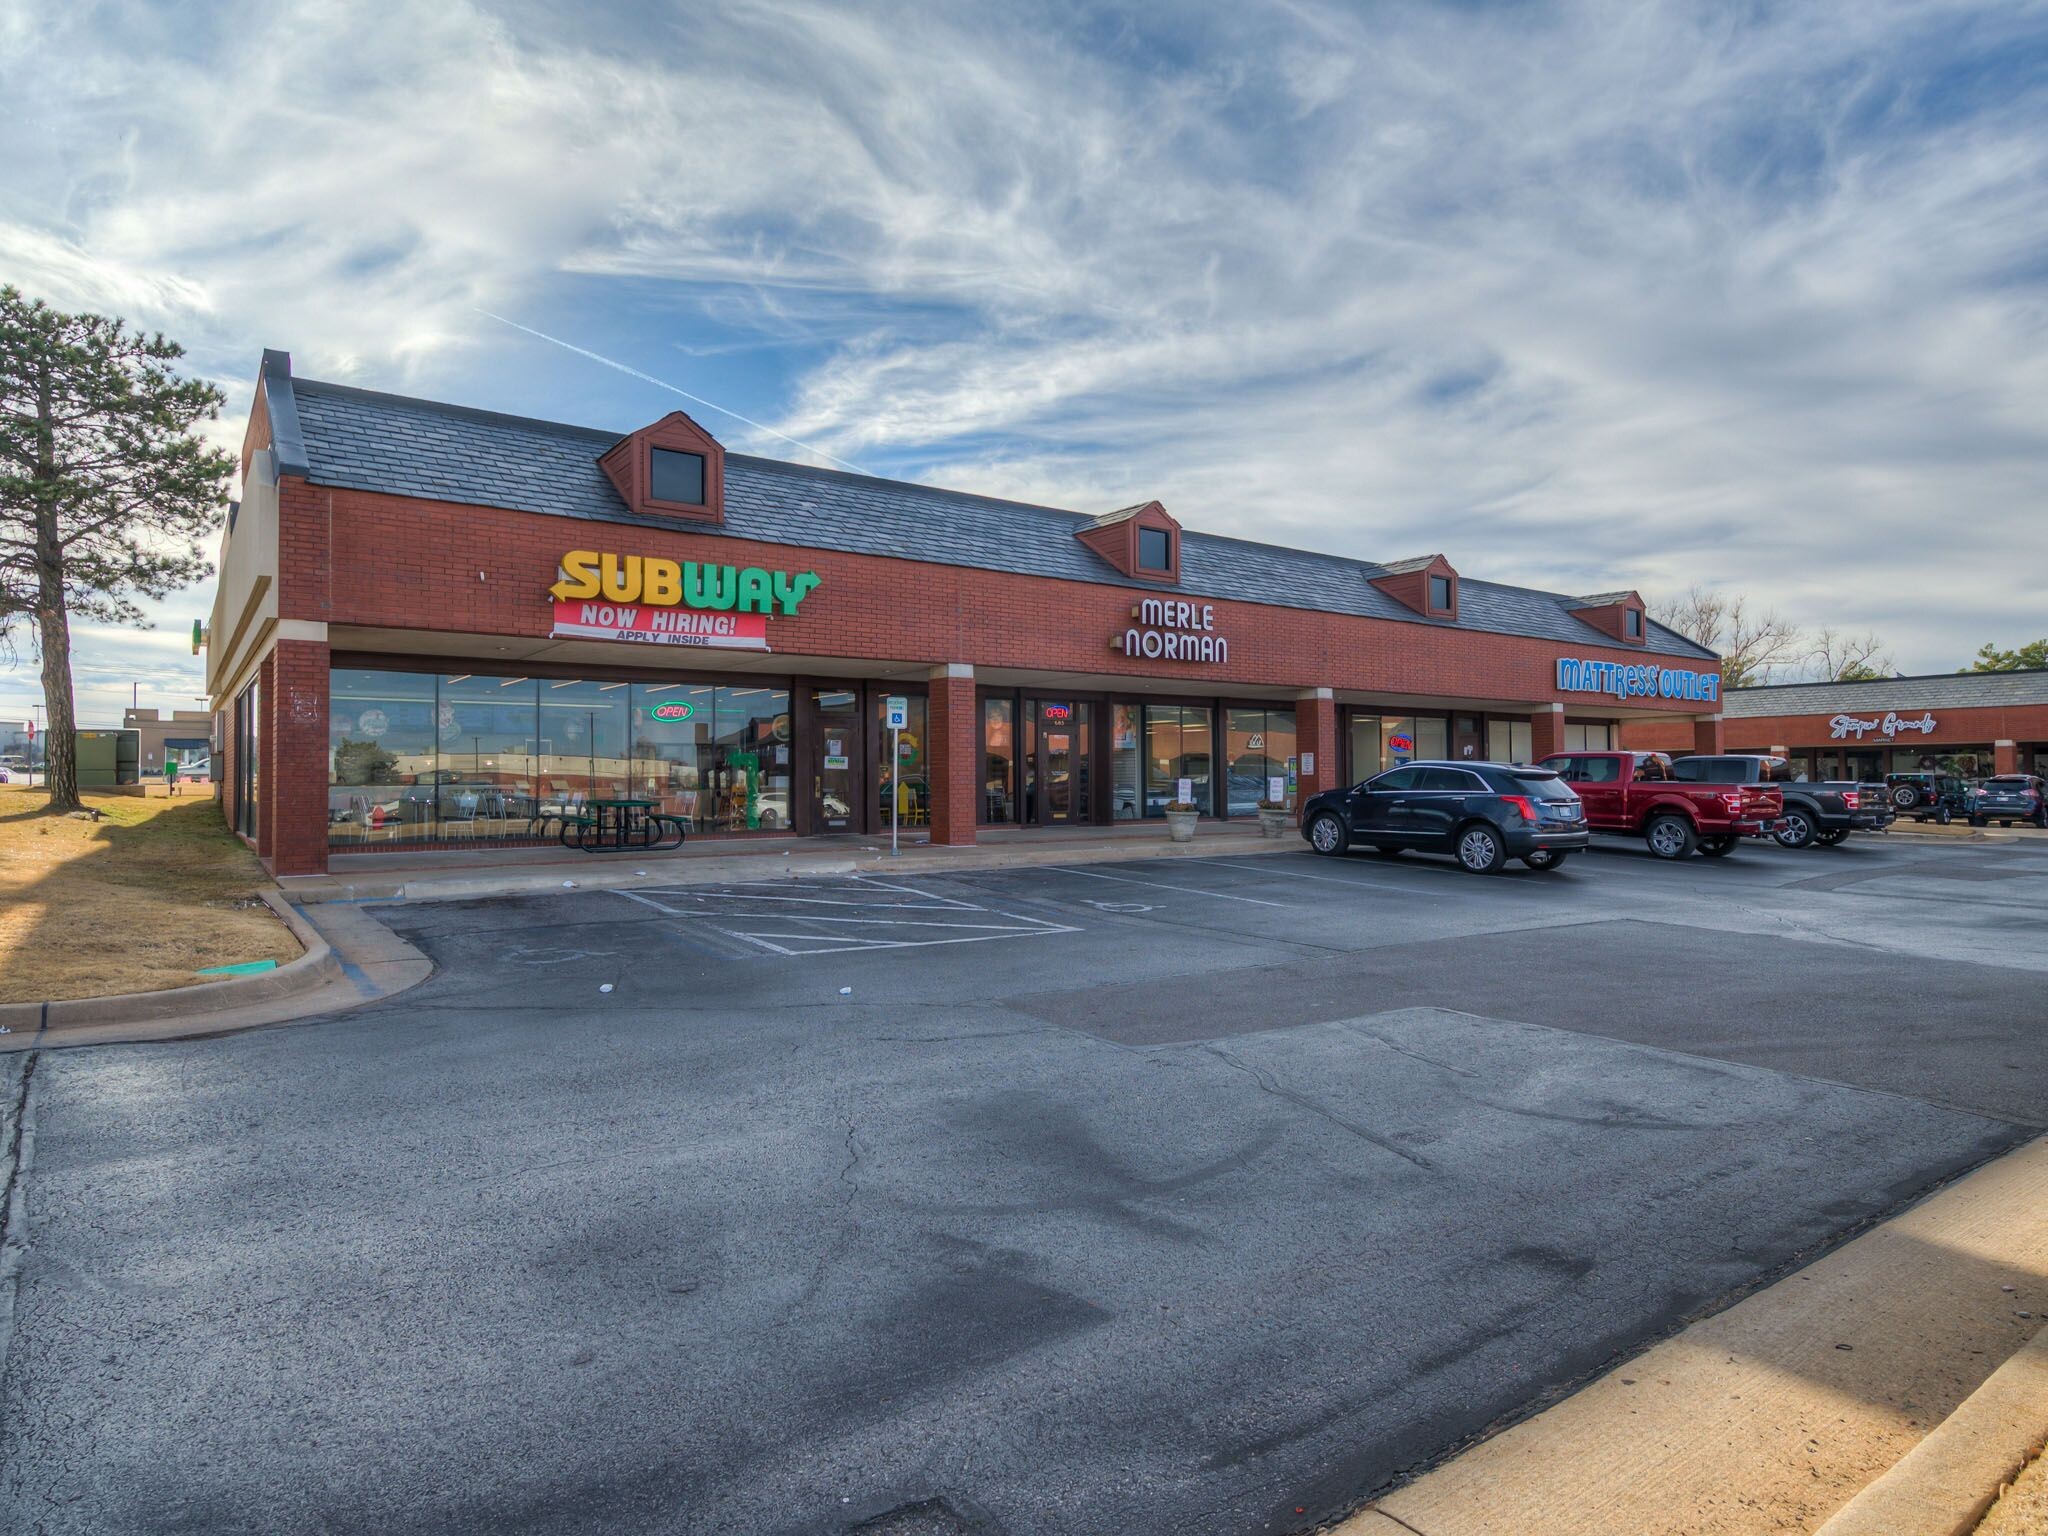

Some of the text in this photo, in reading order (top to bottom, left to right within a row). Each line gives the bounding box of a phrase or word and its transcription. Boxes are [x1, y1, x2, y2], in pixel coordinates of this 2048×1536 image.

[549, 550, 822, 616] SUBWAY
[580, 604, 736, 636] NOW HIRING!
[1141, 598, 1214, 631] MERLE
[616, 629, 710, 646] APPLY INSIDE
[1125, 628, 1228, 664] NORMAN
[656, 705, 689, 717] OPEN
[1046, 707, 1069, 719] OPEN
[1882, 712, 1937, 737] Grounds
[1389, 735, 1413, 750] OPEN
